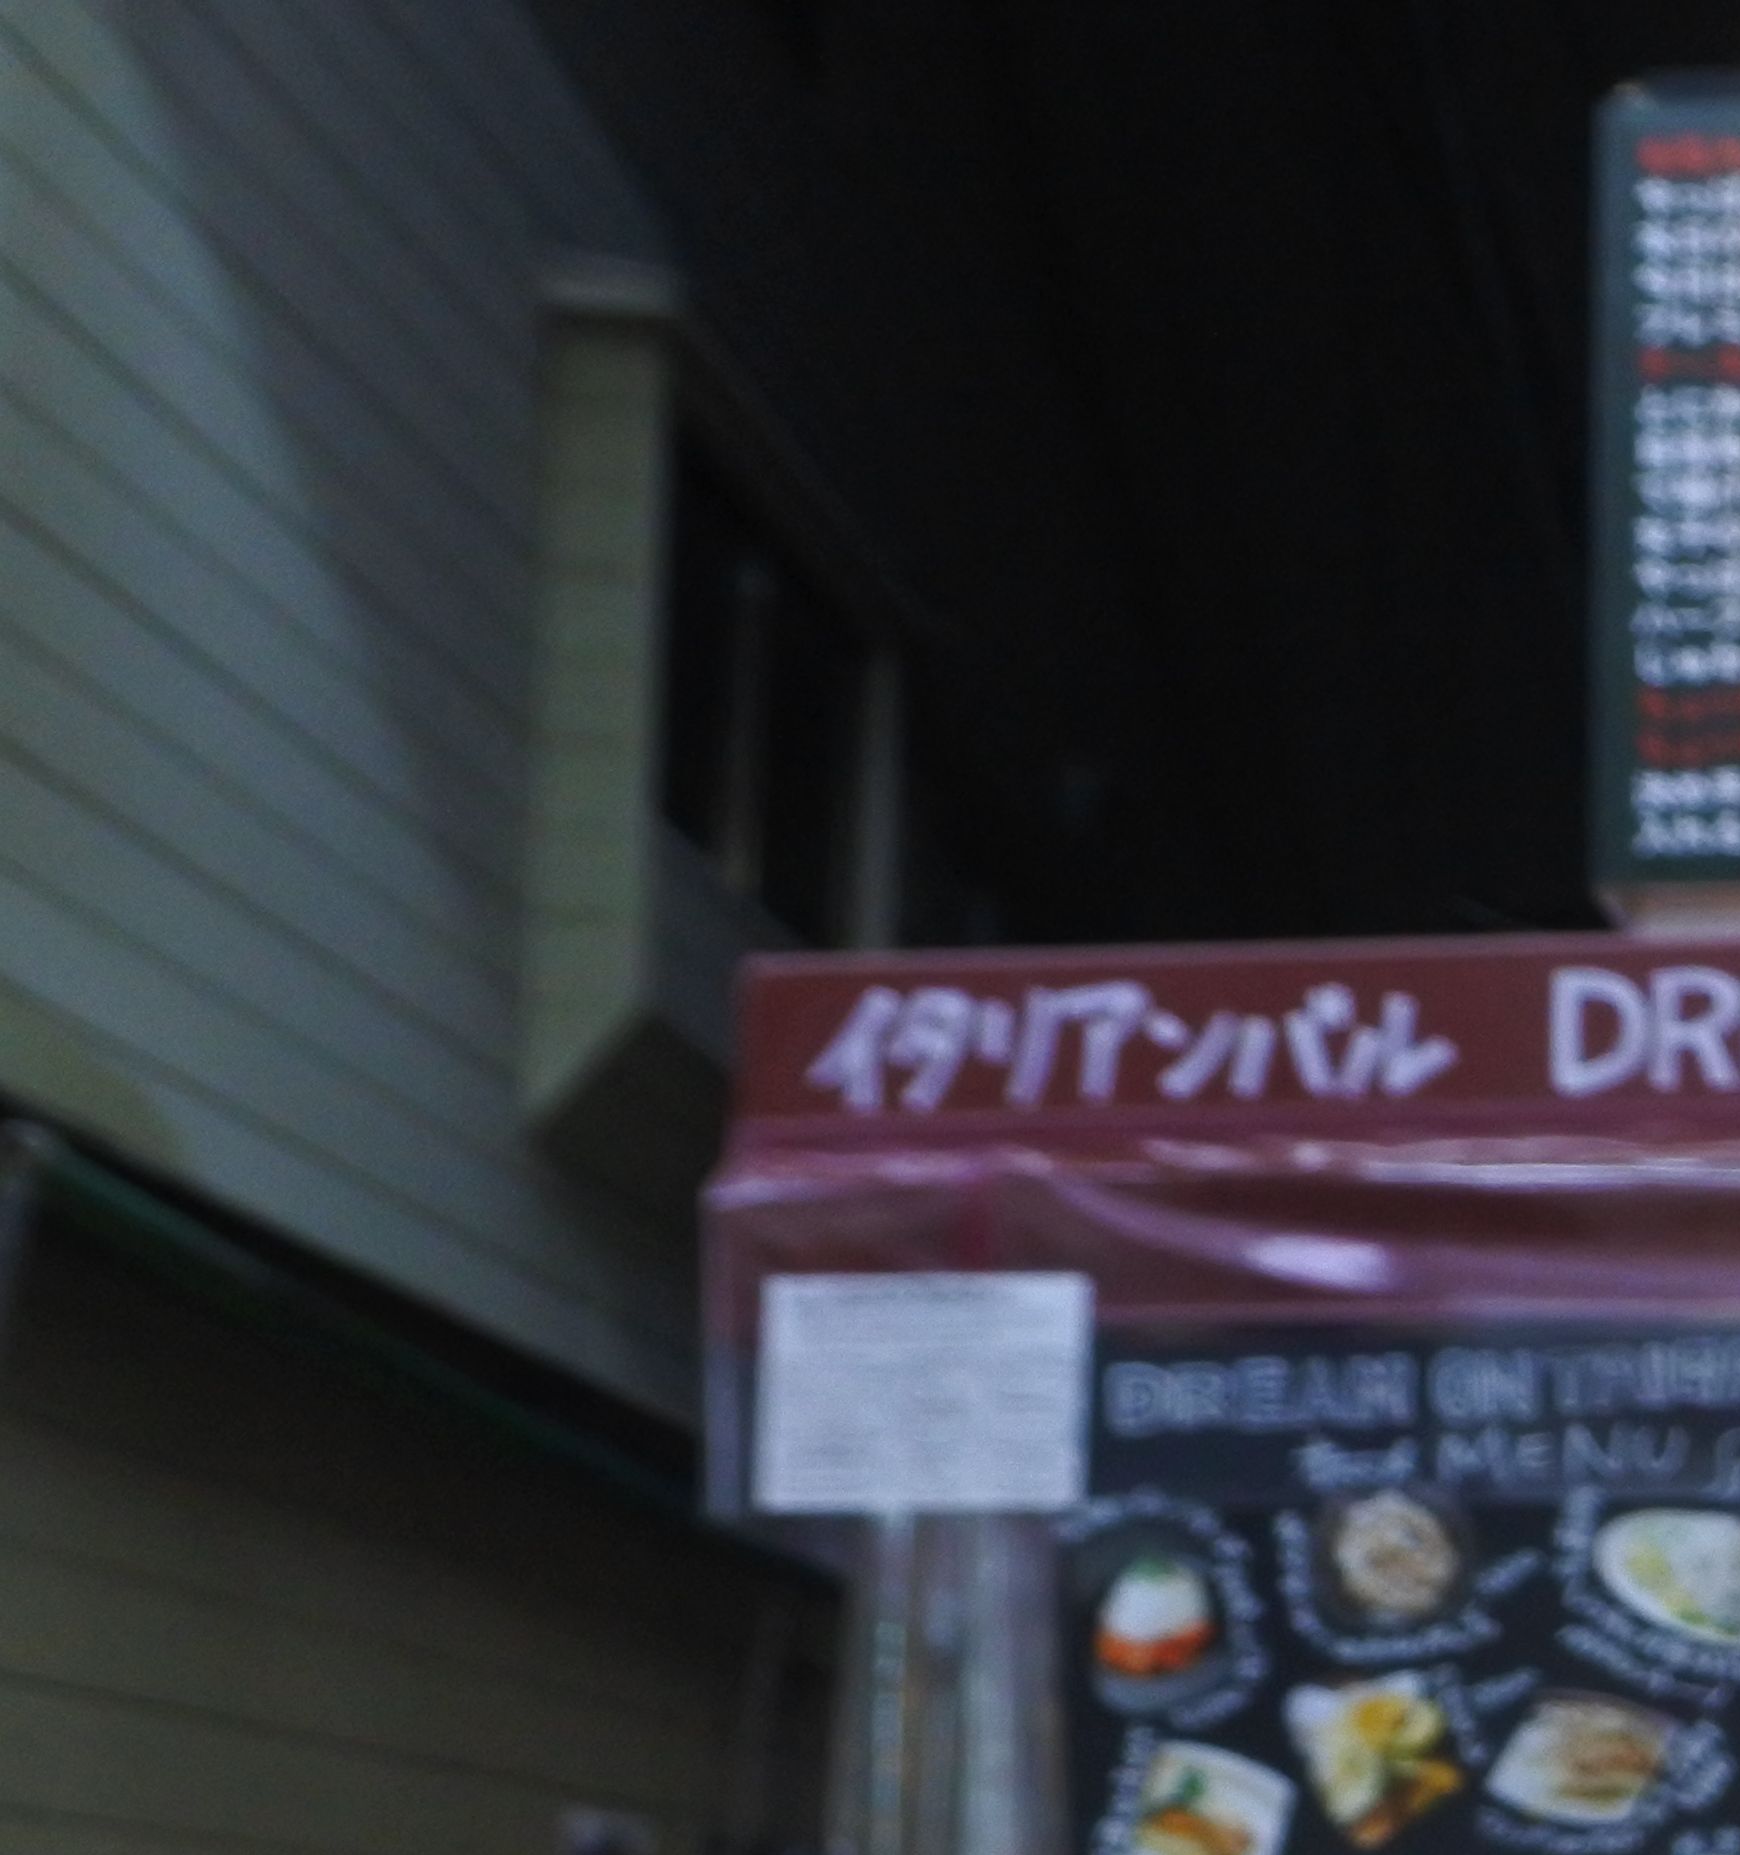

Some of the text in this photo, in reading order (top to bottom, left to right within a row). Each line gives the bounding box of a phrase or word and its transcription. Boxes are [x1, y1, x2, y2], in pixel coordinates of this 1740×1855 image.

[1103, 1353, 1419, 1438] DREAM
[1428, 1344, 1543, 1425] ON
[1435, 1423, 1692, 1486] MENU
